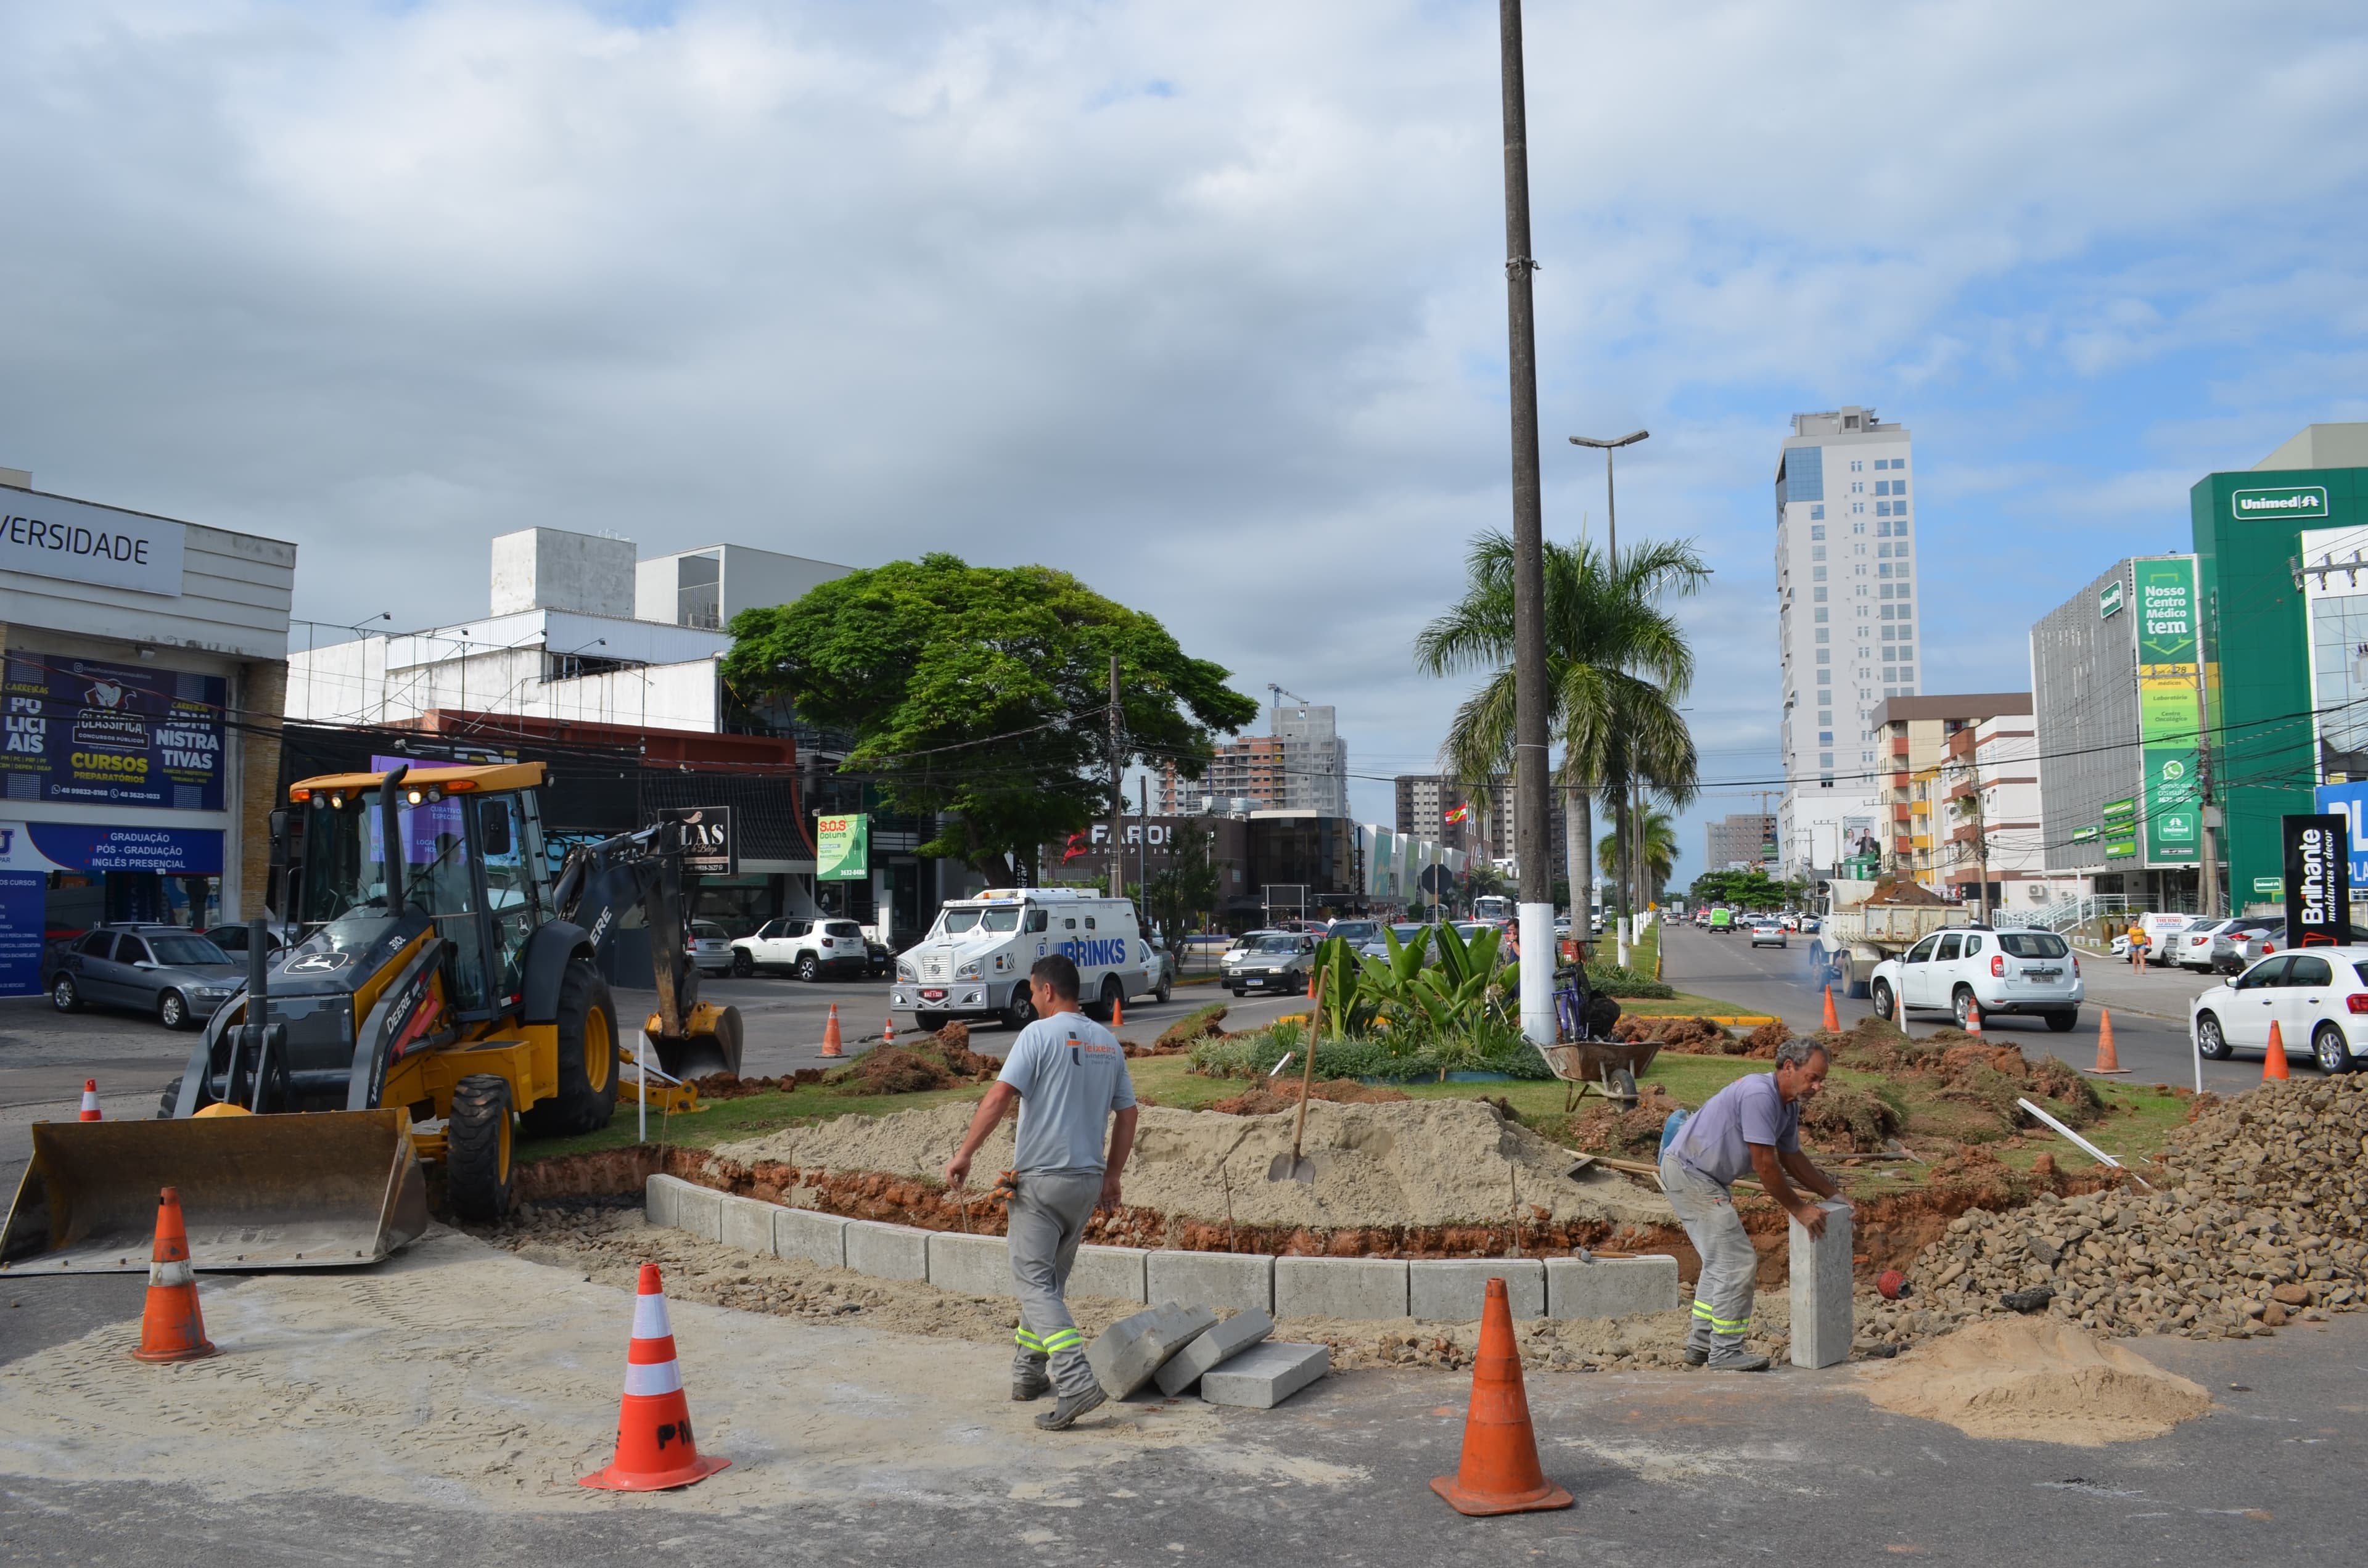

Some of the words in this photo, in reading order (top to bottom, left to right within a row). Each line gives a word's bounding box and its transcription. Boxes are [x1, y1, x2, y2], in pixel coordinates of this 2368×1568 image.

[2241, 496, 2298, 510] Unimed
[2145, 586, 2185, 596] Nosso
[2145, 597, 2186, 607] Centro
[2146, 608, 2187, 618] Médico
[2147, 619, 2188, 634] tem
[2175, 666, 2187, 674] 28
[5, 684, 49, 694] CARREIRAS
[11, 697, 42, 714] PO
[6, 716, 46, 734] LICI
[165, 710, 210, 730] ADMI
[6, 733, 44, 753] AIS
[78, 733, 115, 741] CONCURSOS
[116, 736, 145, 744] PÚBLICOS
[156, 729, 220, 750] NISTRA
[71, 752, 149, 773] CURSOS
[162, 749, 213, 770] TIVAS
[73, 771, 146, 783] PREPARATÓRIOS
[820, 820, 846, 832] S.O.S
[110, 832, 170, 844] GRADUAÇÃO
[2323, 830, 2334, 860] decor
[96, 844, 117, 854] PÓS
[124, 845, 183, 857] GRADUAÇÃO
[92, 856, 126, 867] INGLÊS
[129, 858, 186, 868] PRESENCIAL
[2299, 829, 2324, 924] Brilhante
[2324, 870, 2336, 922] molduras
[388, 934, 407, 951] 310L
[1064, 938, 1125, 967] BRINKS
[387, 991, 411, 1035] DEERE
[1083, 1042, 1116, 1054] Teixeira
